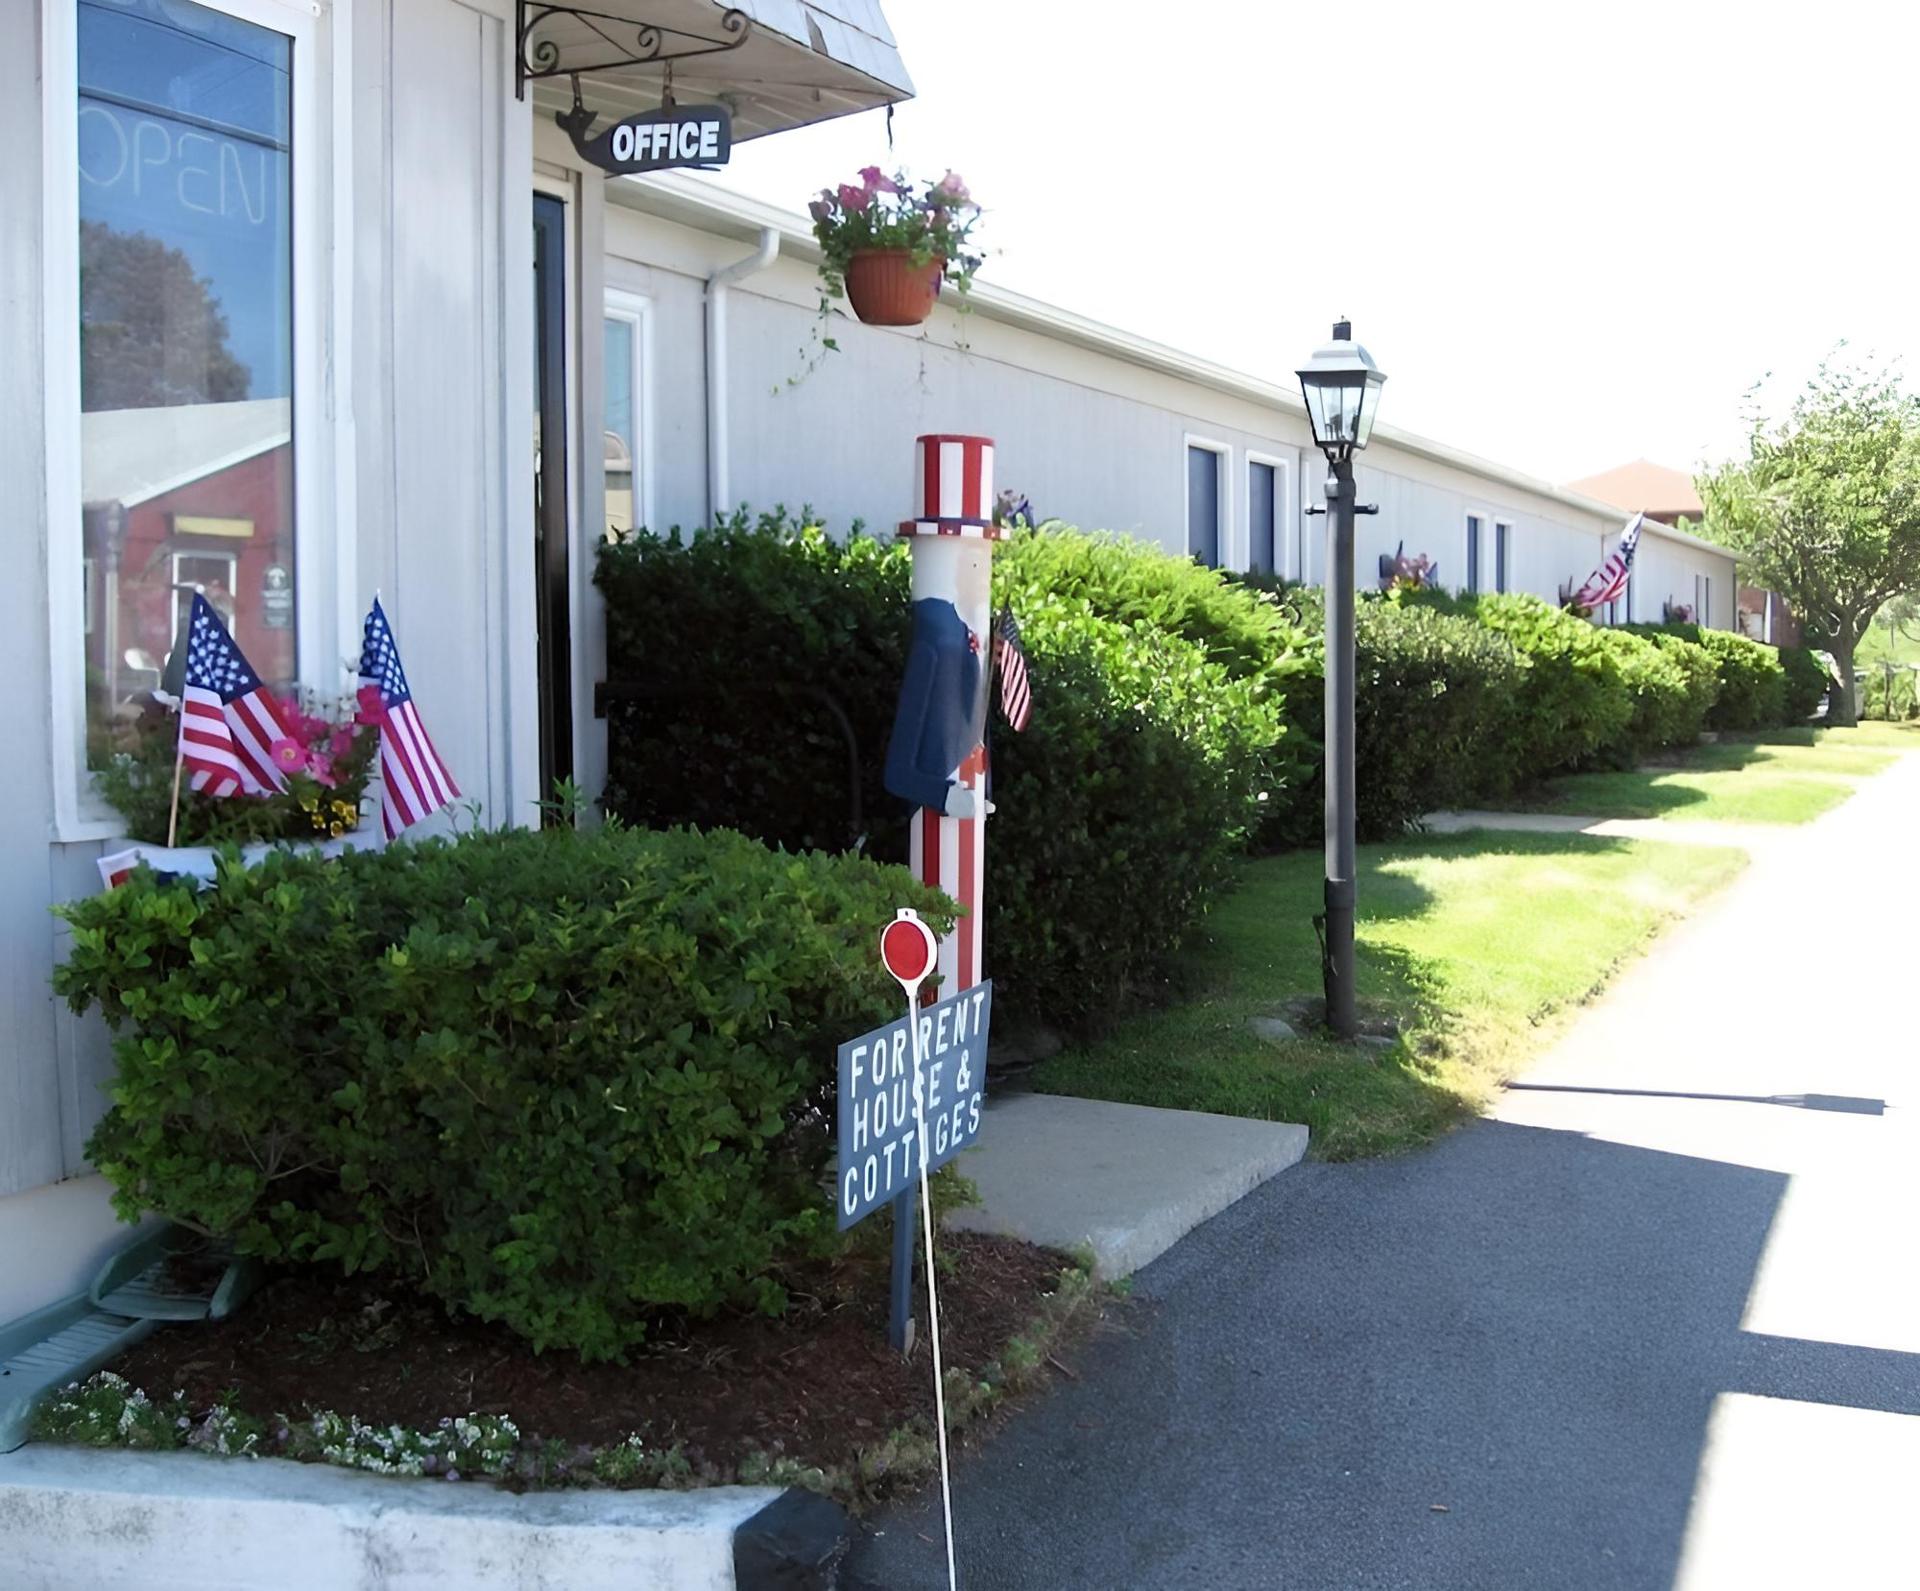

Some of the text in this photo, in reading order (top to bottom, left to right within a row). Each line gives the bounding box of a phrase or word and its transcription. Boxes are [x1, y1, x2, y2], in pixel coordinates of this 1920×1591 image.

[78, 107, 265, 224] OPEN
[612, 121, 720, 162] OFFICE
[851, 991, 985, 1098] FOR RENT
[956, 1049, 972, 1093] &
